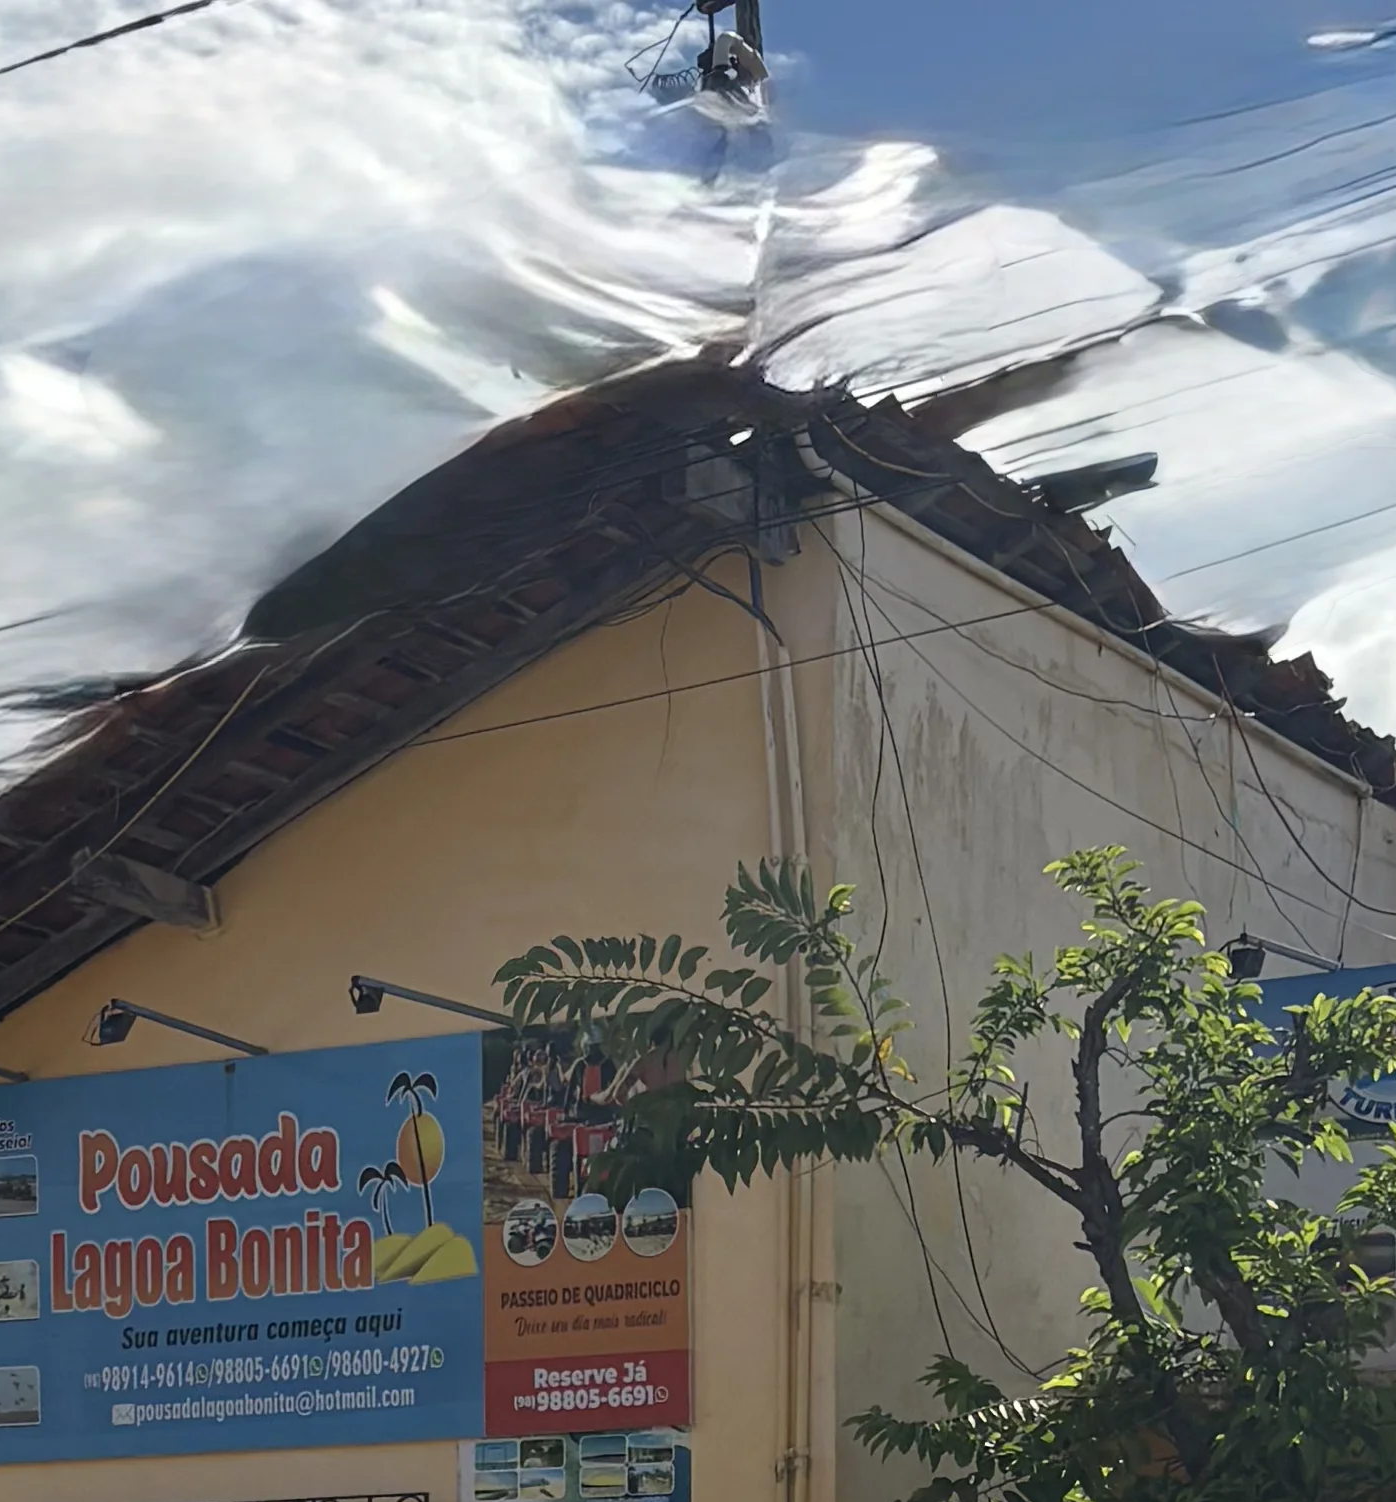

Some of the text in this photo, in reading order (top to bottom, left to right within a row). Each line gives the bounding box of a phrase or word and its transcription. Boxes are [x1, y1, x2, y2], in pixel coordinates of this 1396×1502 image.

[78, 1112, 342, 1214] Pousada
[50, 1207, 377, 1319] Lagoa Bonita
[501, 1280, 680, 1310] PASSEIO DE QUADRICICLO
[121, 1308, 403, 1350] Sua aventura começa aqui
[572, 1315, 589, 1331] dia
[534, 1360, 647, 1388] Reserve Já
[136, 1386, 415, 1426] pousadalagoabonita@hotmail.com
